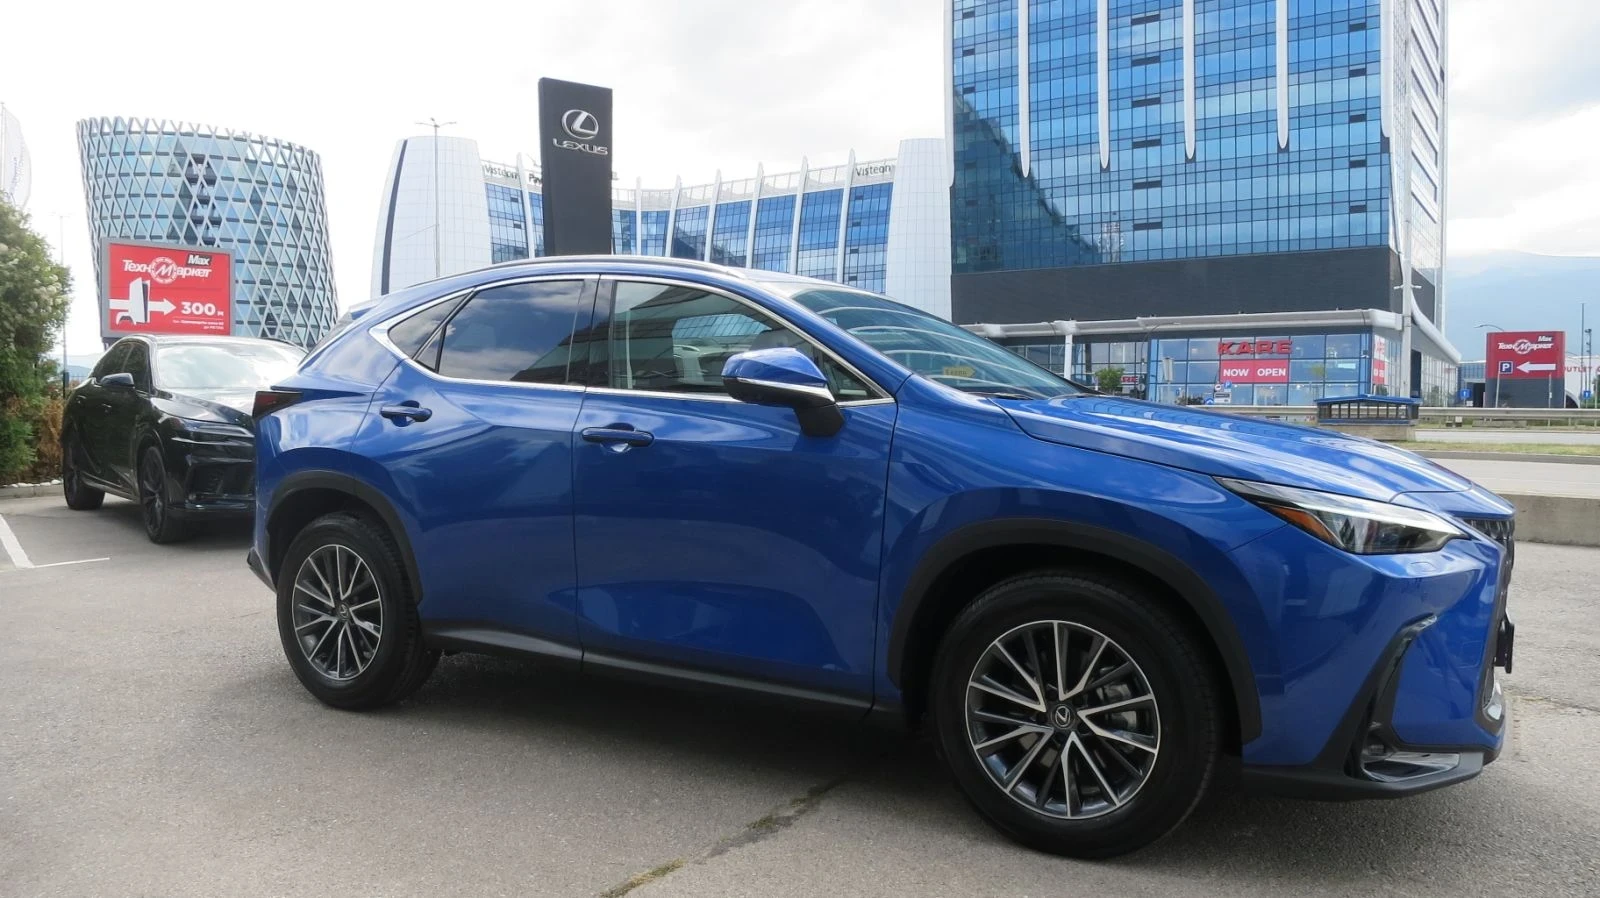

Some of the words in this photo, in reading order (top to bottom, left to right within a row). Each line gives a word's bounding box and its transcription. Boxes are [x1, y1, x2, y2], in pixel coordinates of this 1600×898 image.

[552, 138, 608, 155] LEXUS
[855, 164, 891, 176] Visteon
[188, 254, 210, 266] Max
[181, 301, 216, 316] 300
[1217, 340, 1293, 356] KARE
[1223, 368, 1250, 377] NOW
[1257, 367, 1286, 377] OPEN
[1502, 363, 1510, 372] P
